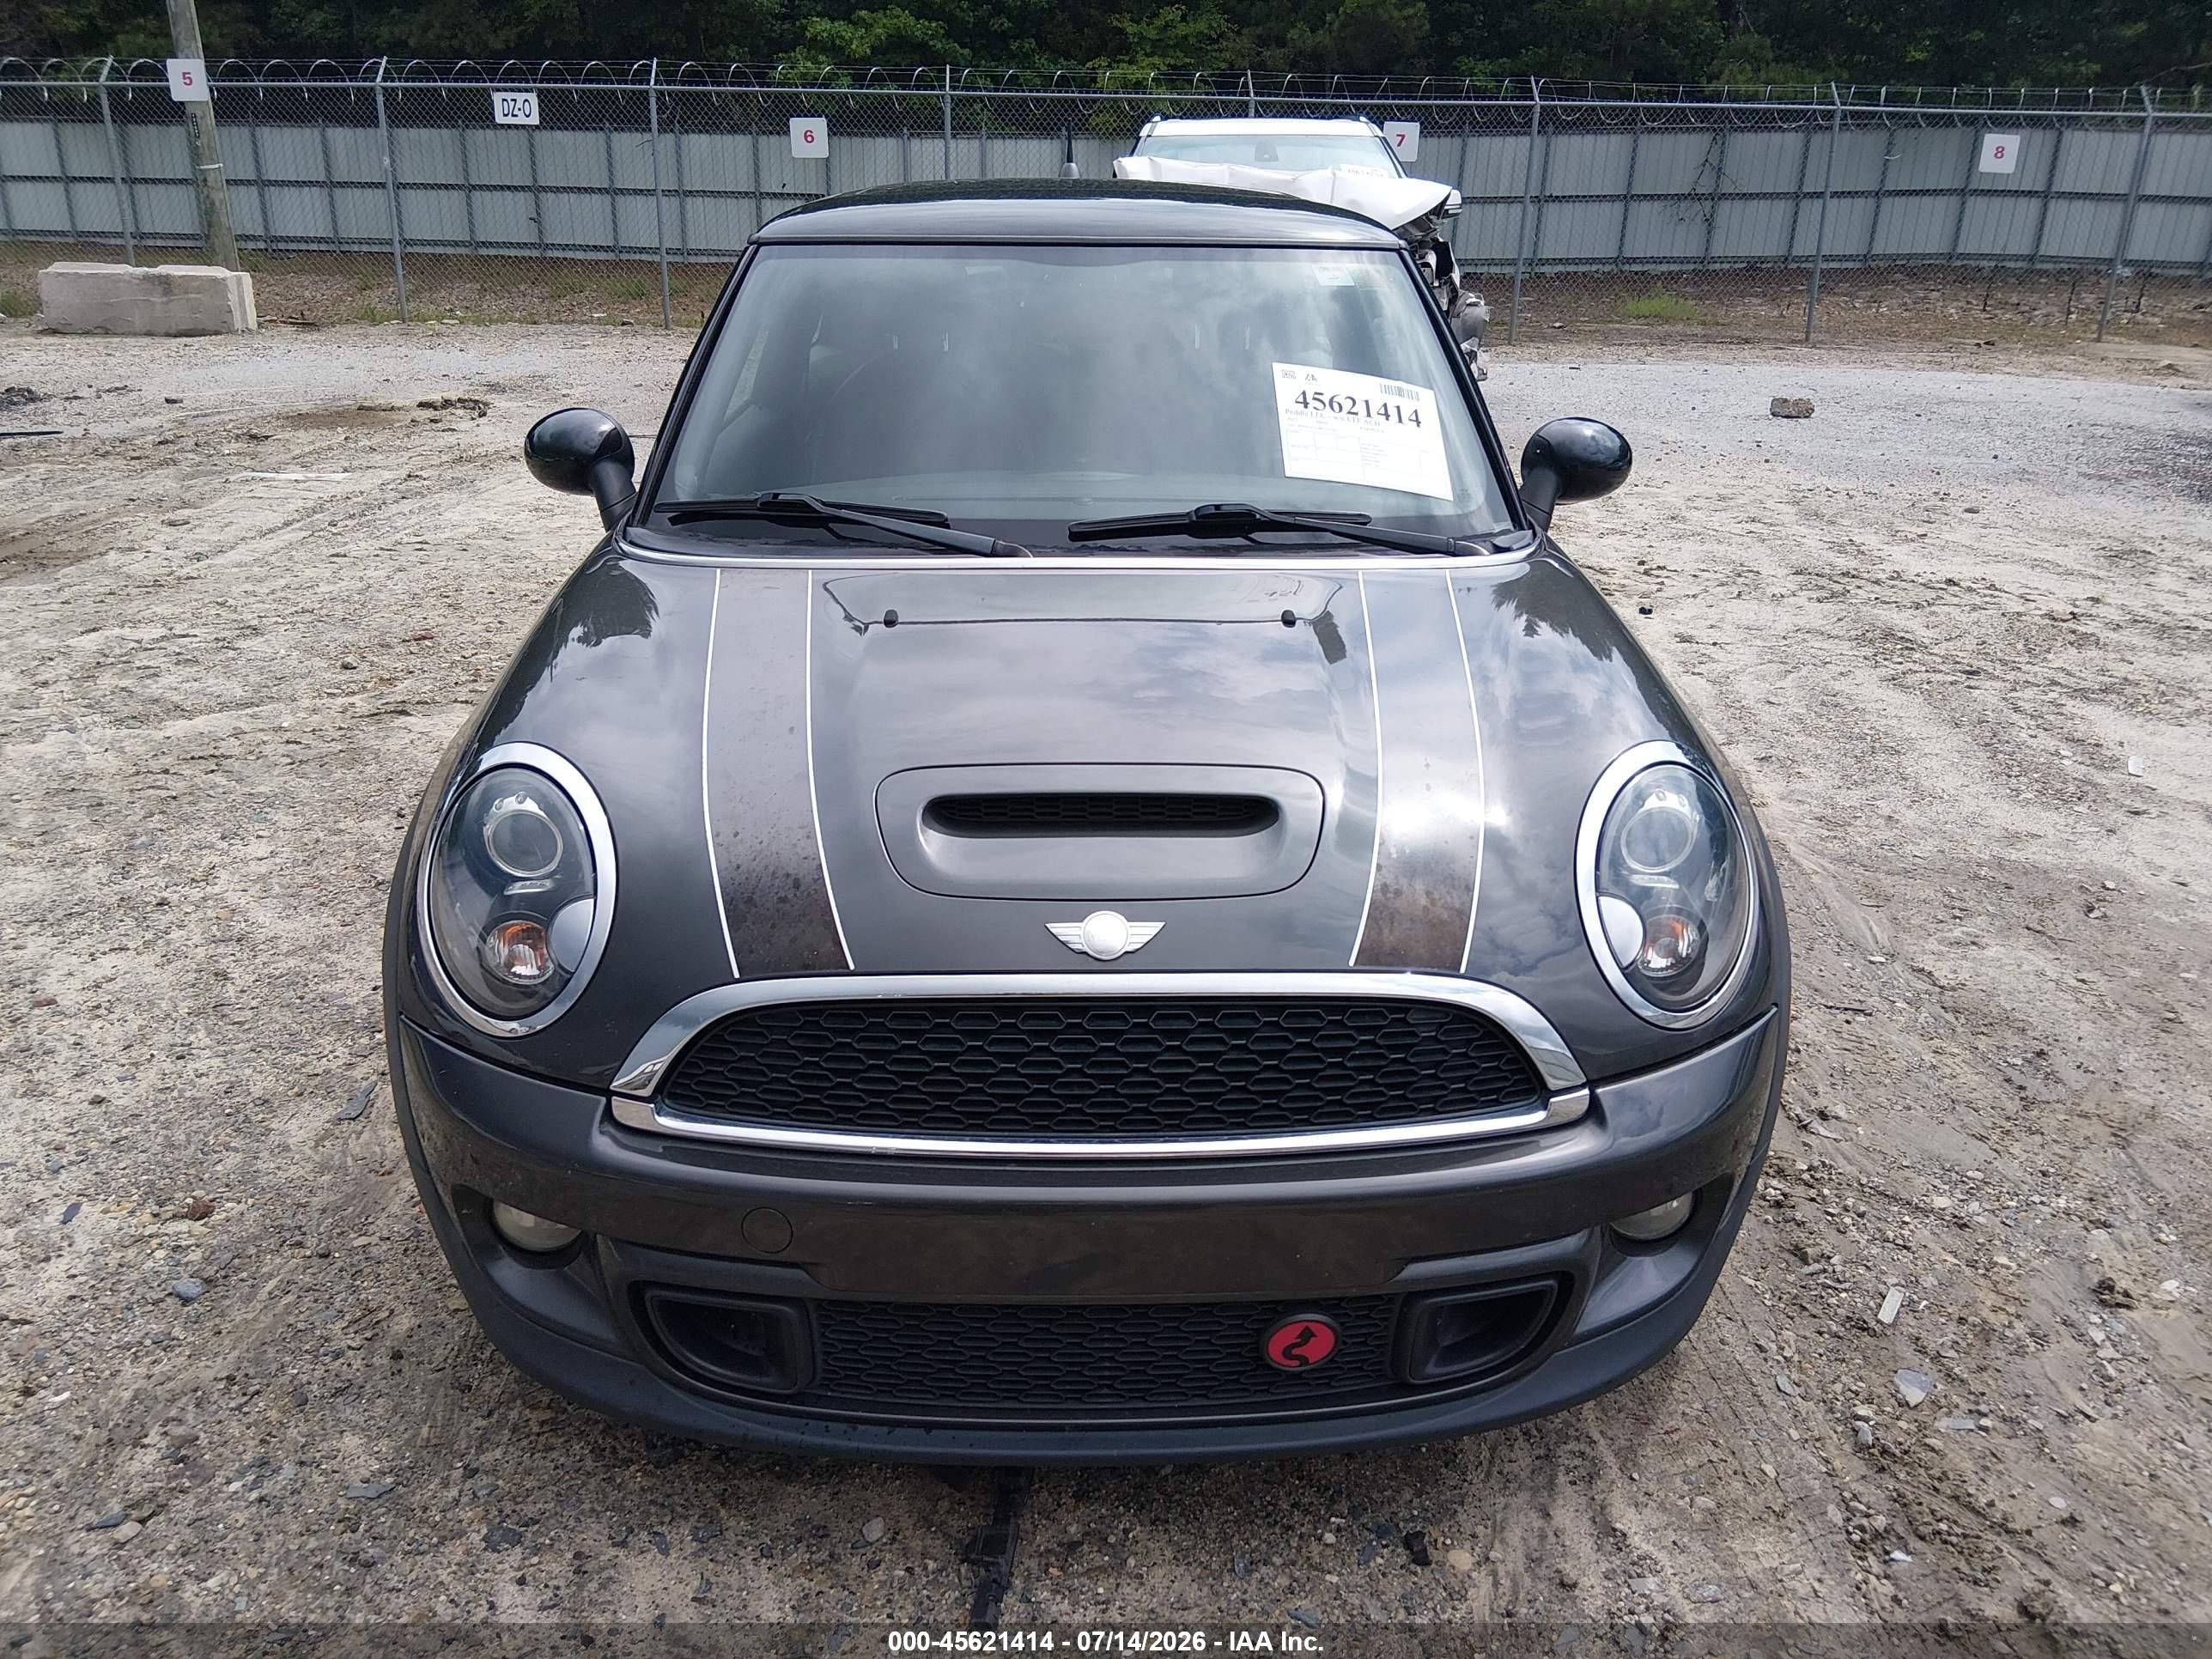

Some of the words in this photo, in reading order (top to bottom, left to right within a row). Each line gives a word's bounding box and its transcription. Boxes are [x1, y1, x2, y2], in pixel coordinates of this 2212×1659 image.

[181, 71, 193, 86] 5
[803, 129, 815, 143] 6
[1395, 134, 1406, 147] 7
[1993, 145, 2005, 159] 8
[1294, 389, 1422, 428] 45621414
